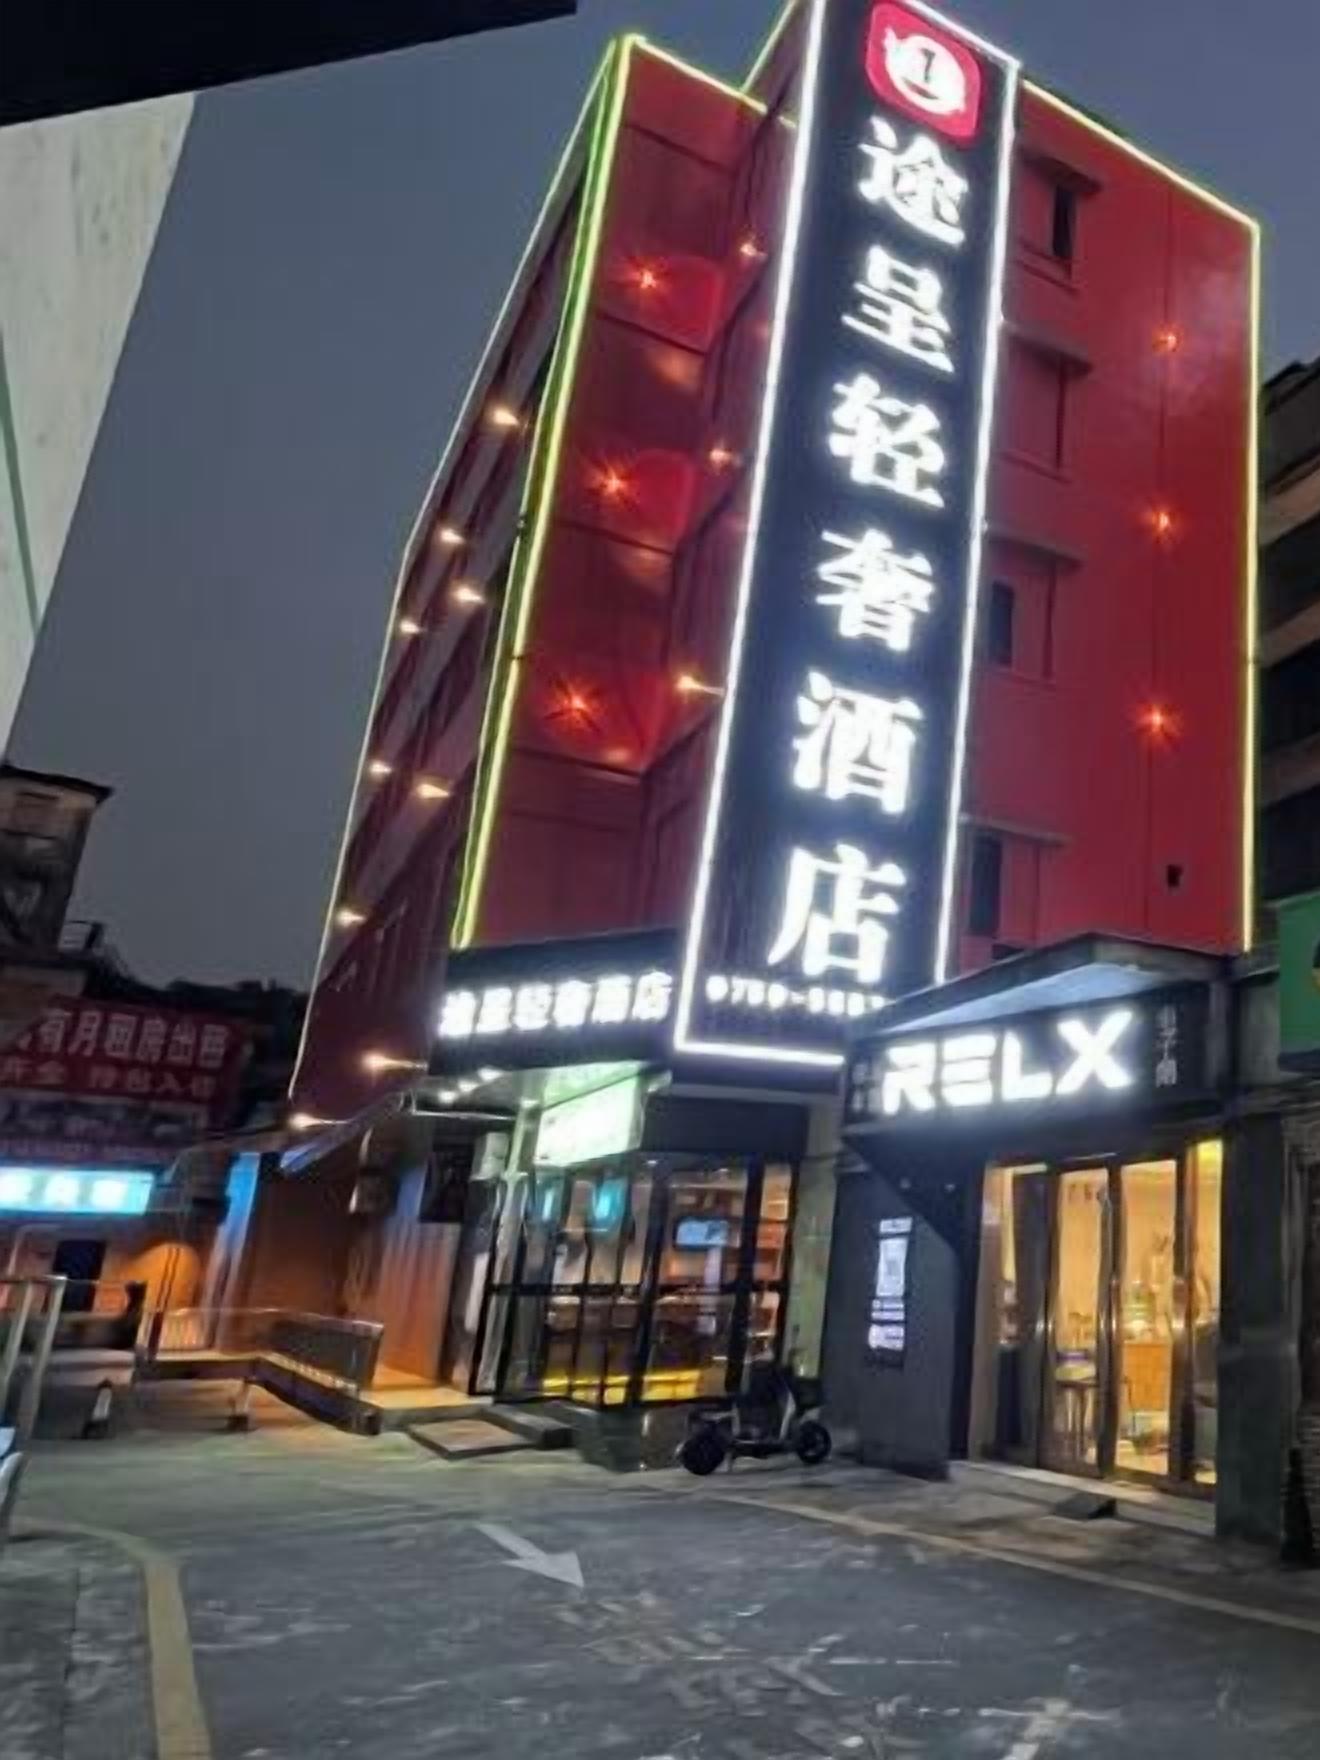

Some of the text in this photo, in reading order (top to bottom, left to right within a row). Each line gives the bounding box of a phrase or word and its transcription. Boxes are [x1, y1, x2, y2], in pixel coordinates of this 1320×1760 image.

[768, 115, 971, 985] 途呈轻奢酒店
[17, 1008, 229, 1069] 有月租房出租
[883, 1010, 1133, 1115] RELX
